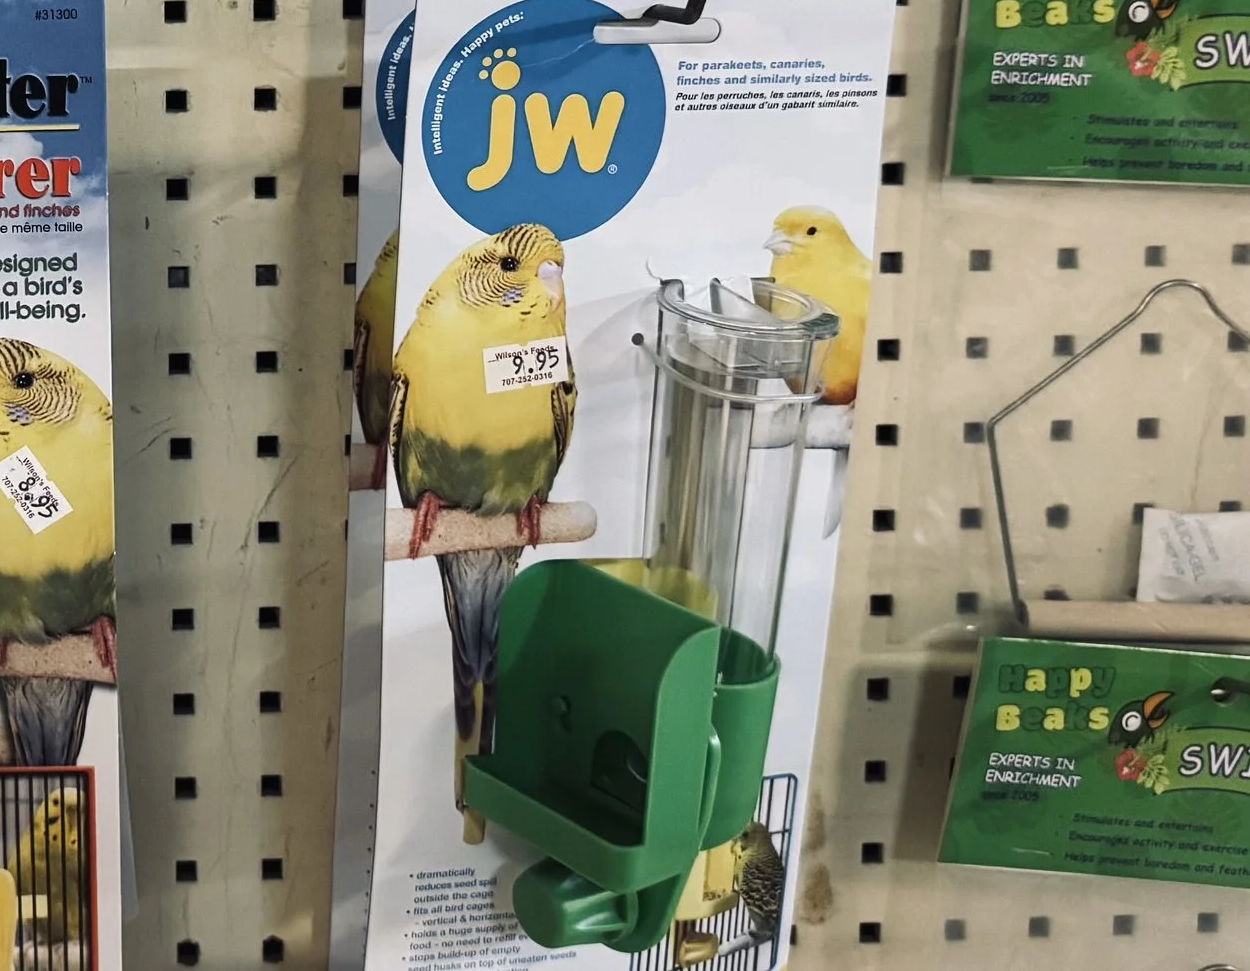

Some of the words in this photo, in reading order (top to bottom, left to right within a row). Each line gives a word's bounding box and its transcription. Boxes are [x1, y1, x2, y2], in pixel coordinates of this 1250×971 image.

[35, 9, 78, 20] #31300
[495, 11, 524, 32] pets:
[461, 28, 494, 57] Happy
[678, 61, 698, 71] For
[702, 60, 767, 72] parakeets,
[770, 58, 825, 70] canaries,
[993, 52, 1058, 67] EXPERTS
[1063, 54, 1084, 67] IN
[438, 59, 464, 92] ideas.
[677, 75, 720, 86] finches
[724, 75, 747, 85] and
[750, 73, 801, 86] similarly
[805, 73, 836, 83] sized
[839, 72, 873, 83] birds.
[991, 71, 1092, 86] ENRICHMENT
[384, 64, 397, 121] Intelligent
[676, 92, 698, 101] Pour
[700, 92, 715, 100] les
[717, 91, 767, 102] perruches,
[431, 93, 446, 156] Intelligent
[467, 60, 625, 191] jw
[24, 203, 80, 218] finches
[12, 222, 50, 233] même
[54, 221, 83, 232] taille
[2, 281, 18, 296] a
[24, 276, 83, 296] bird's
[495, 349, 528, 361] Wilson's
[513, 349, 559, 375] 9.95
[502, 372, 553, 387] 707-252-0316
[23, 457, 45, 486] Wilson's
[2, 476, 36, 519] 707-252-0316
[18, 476, 58, 518] 8.95
[998, 664, 1116, 698] Happy
[995, 701, 1110, 731] Beaks
[989, 753, 1050, 769] EXPERTS
[1055, 757, 1075, 770] IN
[985, 769, 1081, 788] ENRICHMENT
[1133, 837, 1174, 850] activity
[1202, 844, 1249, 855] exercise
[416, 868, 475, 879] dramatically
[454, 879, 477, 889] seed
[410, 941, 431, 950] food
